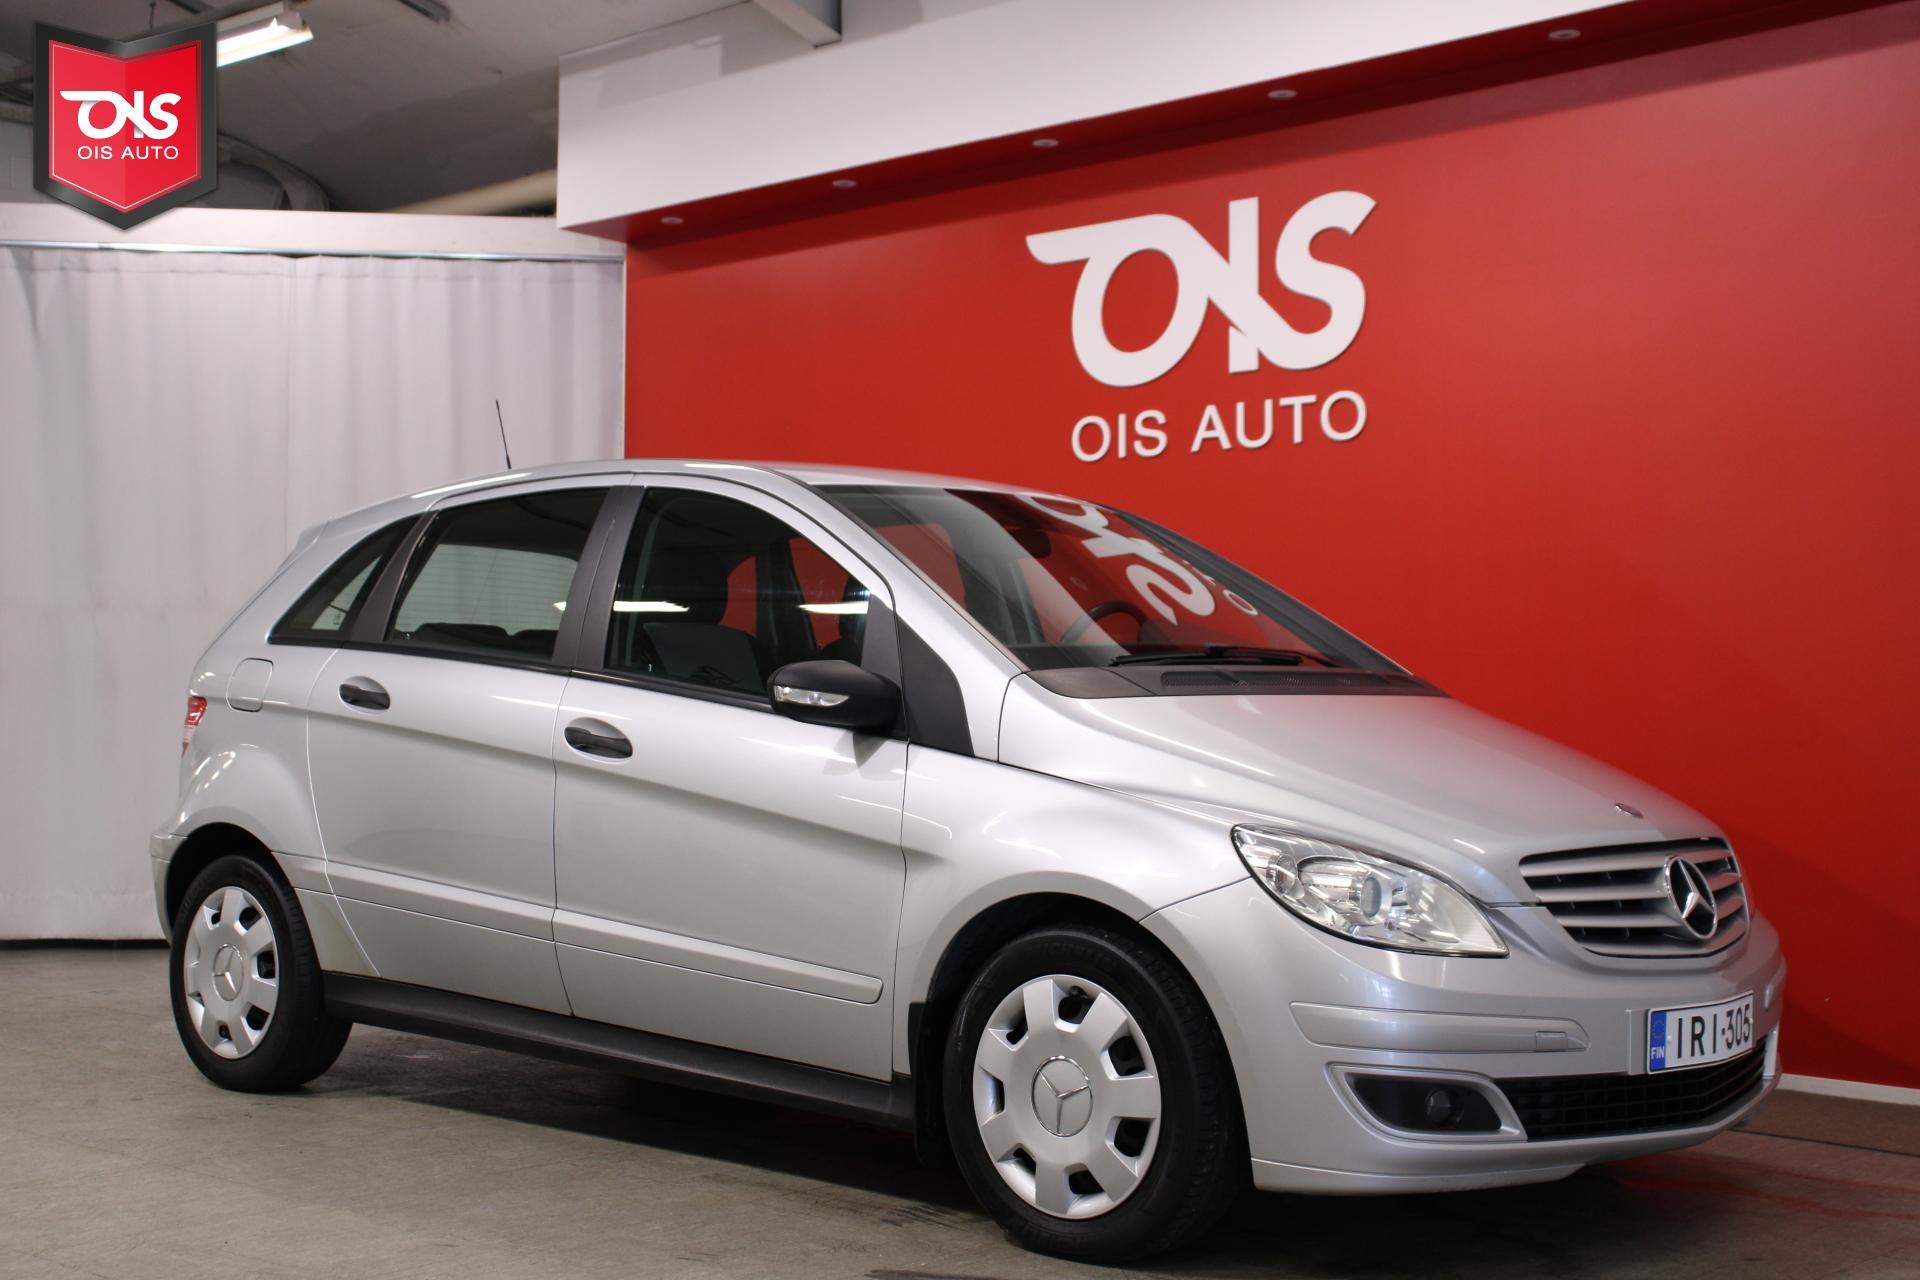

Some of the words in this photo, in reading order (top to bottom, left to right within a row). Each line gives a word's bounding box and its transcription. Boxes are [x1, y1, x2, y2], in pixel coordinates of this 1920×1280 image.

[1025, 190, 1377, 388] OIS
[1071, 410, 1169, 463] OIS
[1190, 390, 1368, 453] AUTO
[1651, 1046, 1665, 1060] FIN
[1677, 1003, 1751, 1059] IRI-305
